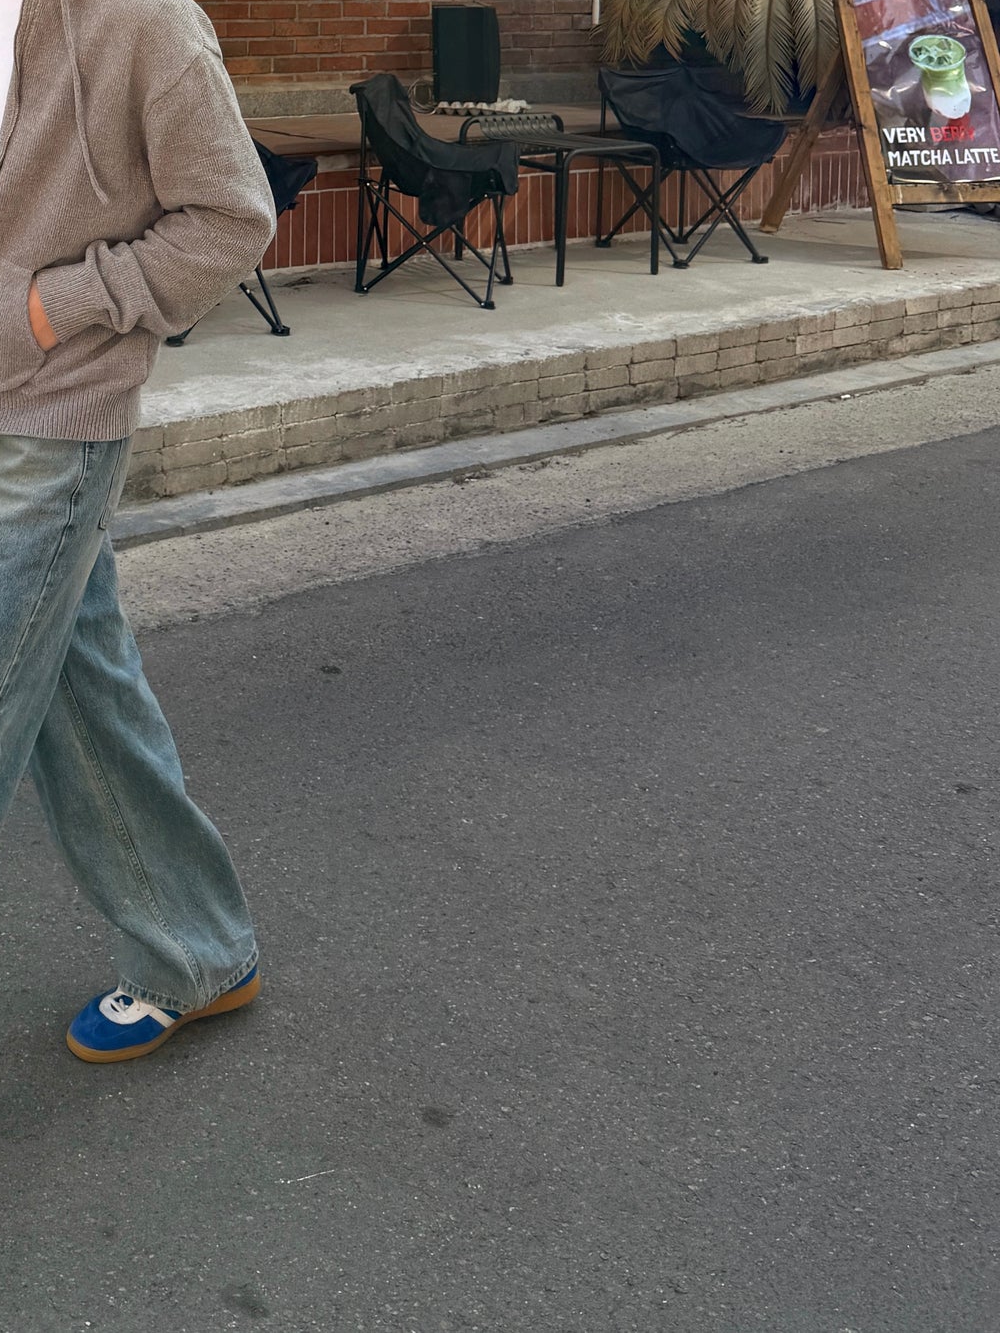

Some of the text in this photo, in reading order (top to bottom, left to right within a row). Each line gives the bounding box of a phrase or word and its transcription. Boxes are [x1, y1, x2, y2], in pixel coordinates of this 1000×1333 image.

[882, 126, 976, 144] VERY BERRY
[887, 147, 1000, 167] MATCHA LATTE
